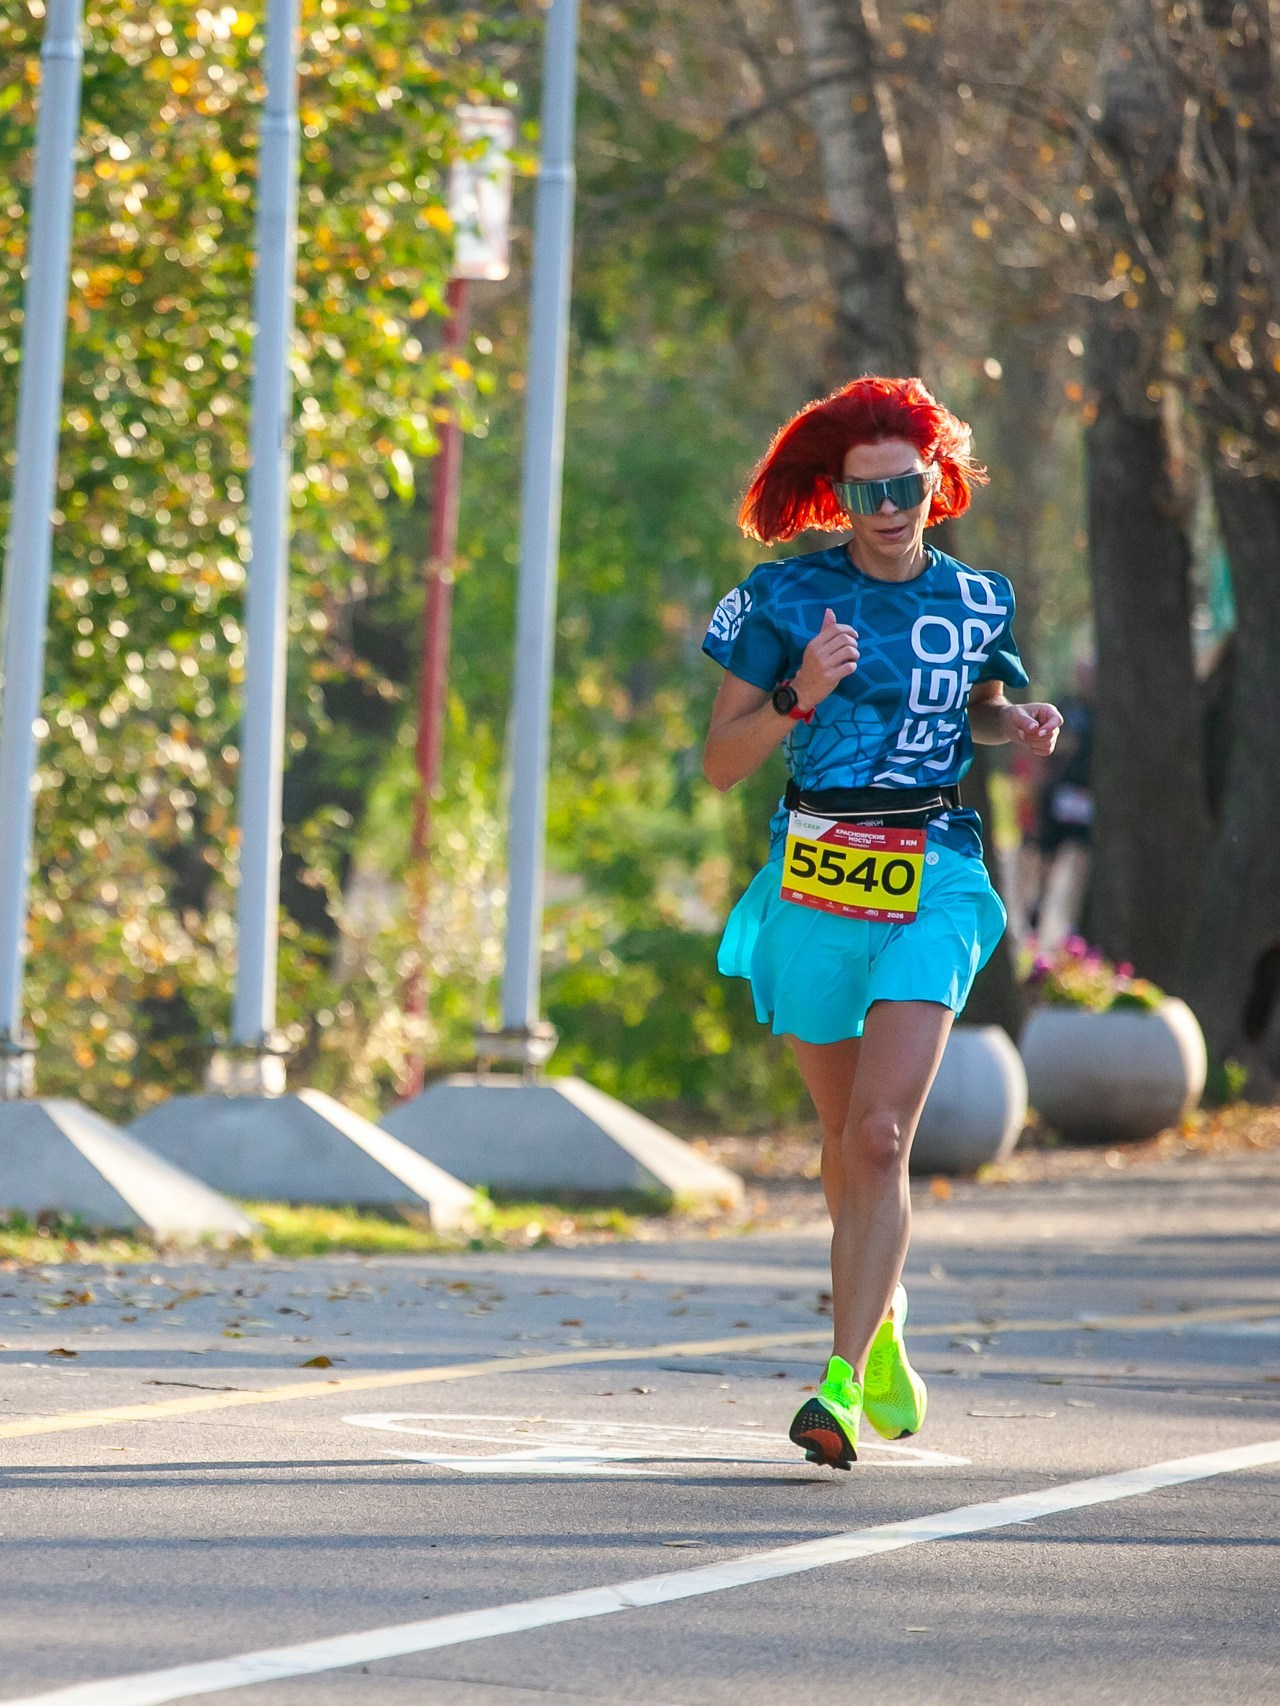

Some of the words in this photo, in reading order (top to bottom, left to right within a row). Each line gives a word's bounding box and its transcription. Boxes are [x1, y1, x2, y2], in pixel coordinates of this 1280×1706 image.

[835, 828, 886, 841] КРАСНОЯРСКИЕ
[847, 836, 872, 845] МОСТЫ
[790, 841, 916, 896] 5540
